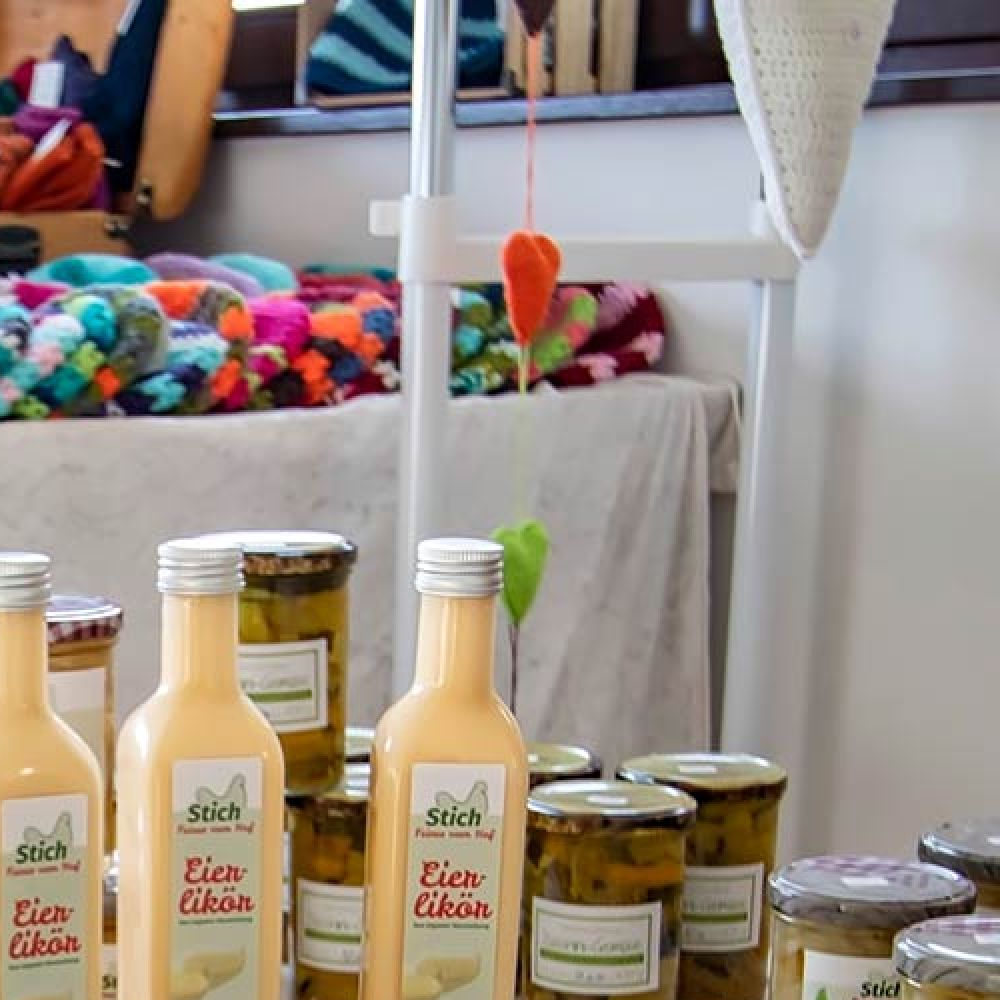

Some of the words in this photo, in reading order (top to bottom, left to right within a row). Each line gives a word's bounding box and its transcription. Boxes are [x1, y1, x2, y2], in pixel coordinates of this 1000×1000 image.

[187, 801, 241, 822] Stich
[426, 806, 481, 827] Stich
[15, 839, 67, 864] Stich
[179, 885, 256, 914] likör
[413, 889, 494, 919] likör
[9, 926, 82, 959] likör
